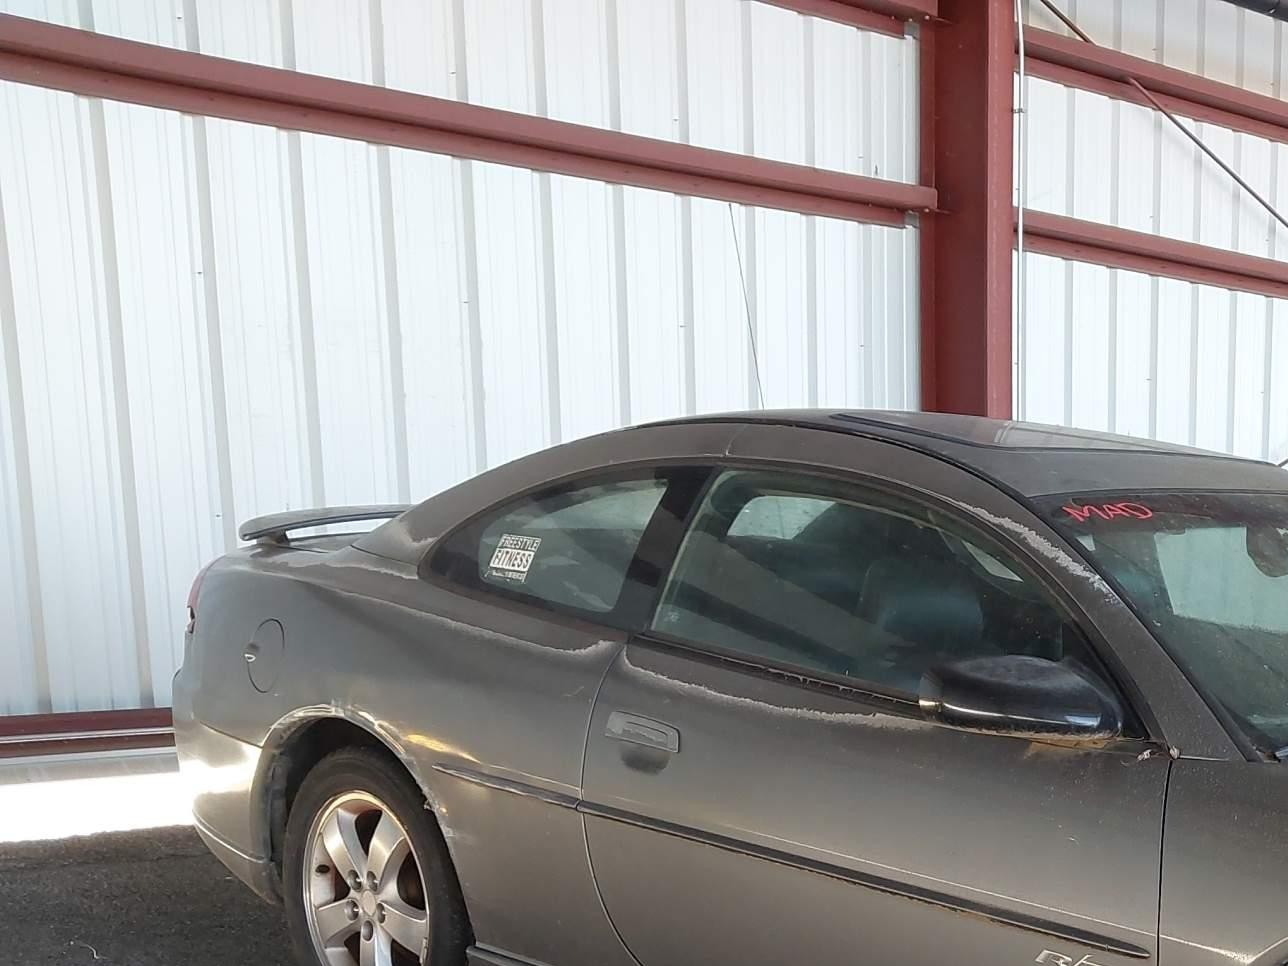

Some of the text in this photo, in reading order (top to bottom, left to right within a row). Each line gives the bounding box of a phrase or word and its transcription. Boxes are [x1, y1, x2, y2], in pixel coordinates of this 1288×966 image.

[1062, 502, 1153, 522] MAD
[498, 535, 539, 551] FREESTYLE
[493, 549, 532, 569] FITNESS
